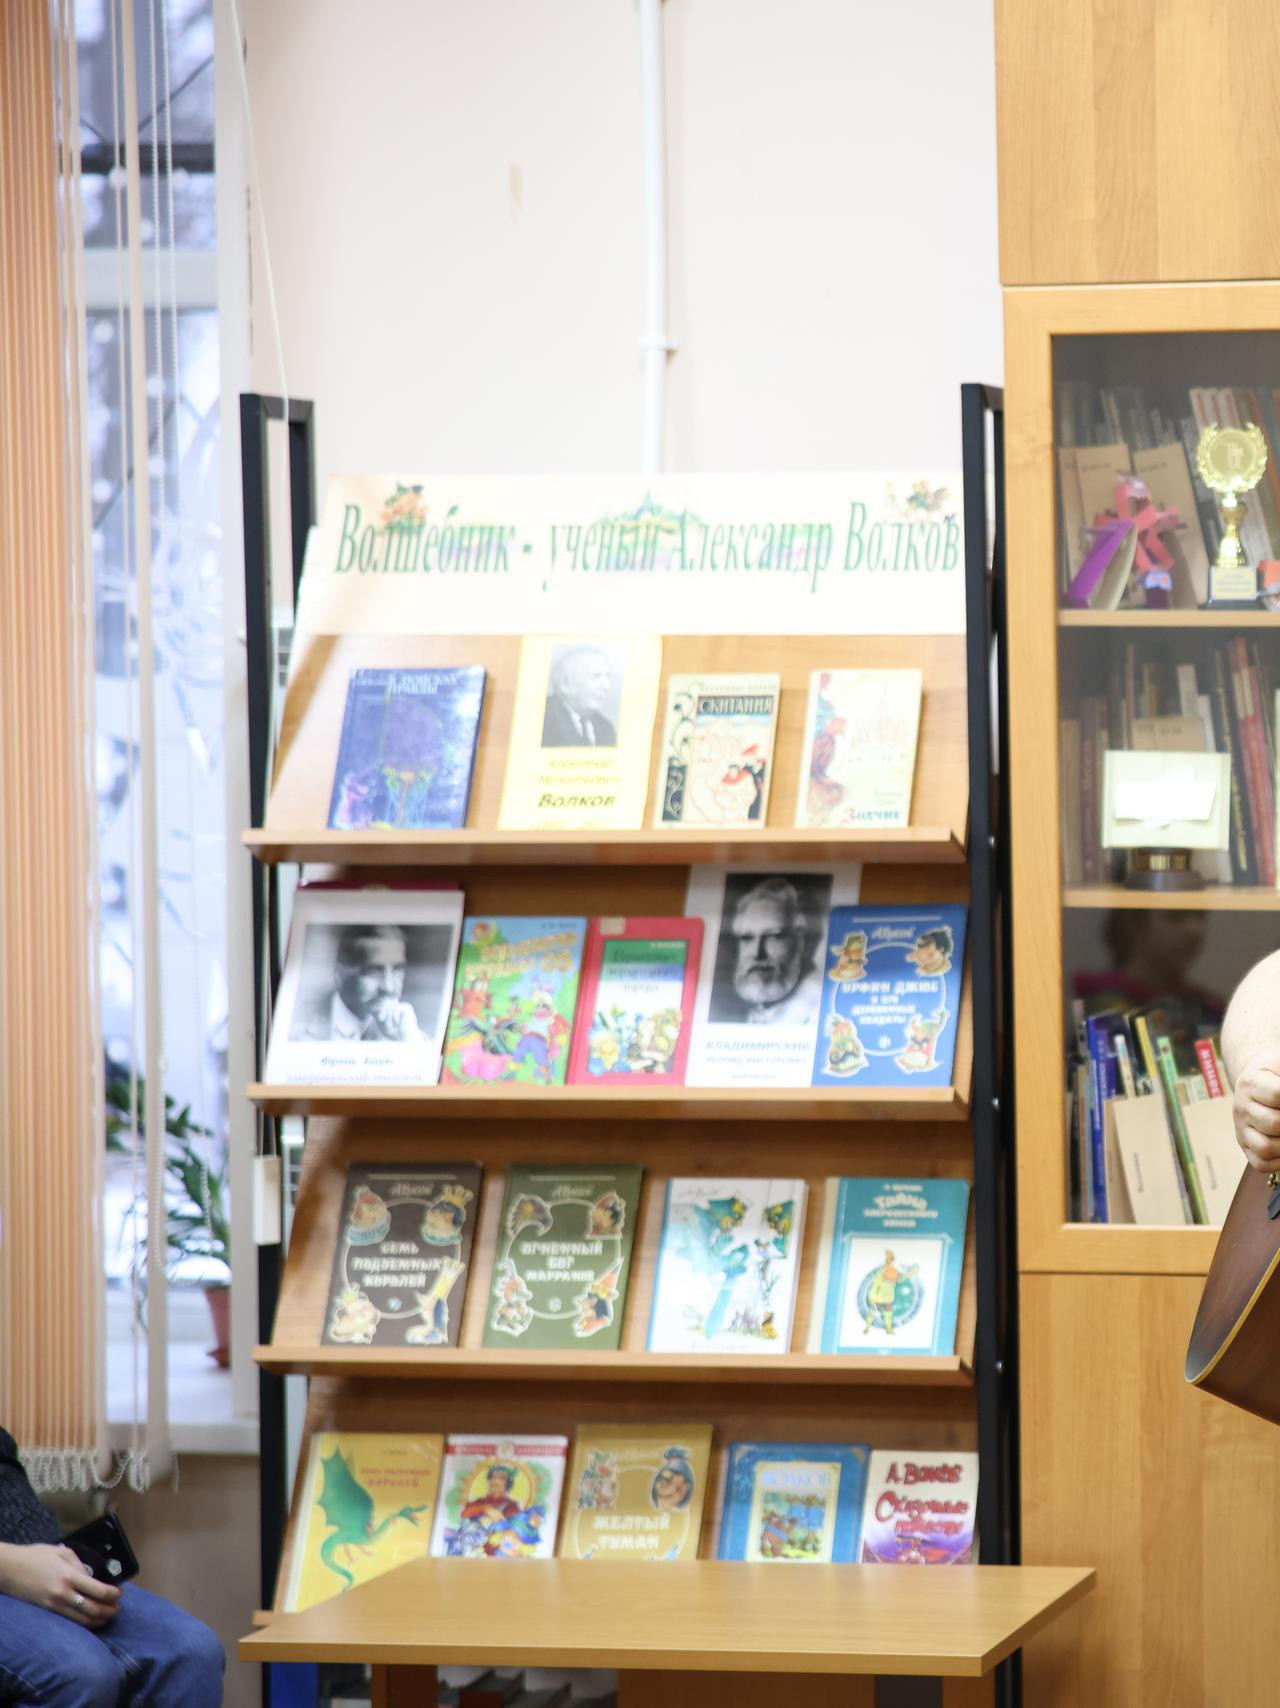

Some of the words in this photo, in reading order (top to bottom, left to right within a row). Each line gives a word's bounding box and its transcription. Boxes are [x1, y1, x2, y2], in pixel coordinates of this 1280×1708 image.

[335, 503, 516, 573] Волшебник
[664, 506, 832, 592] Александр
[843, 502, 960, 572] Волков
[701, 698, 773, 713] СКИТАНИЯ
[538, 793, 616, 808] Волков
[841, 980, 890, 994] УРФИН
[894, 980, 939, 997] ДЖЮС
[706, 1040, 811, 1052] ВЛАДИМИРСКИЙ
[380, 1241, 419, 1254] СЕМЬ
[521, 1240, 603, 1255] ОГНЕННЫЙ
[353, 1257, 441, 1273] ПОДЗЕМНЫХ
[547, 1255, 576, 1270] БОГ
[363, 1271, 426, 1288] КОРОЛЕЙ
[525, 1269, 595, 1281] МАРРАНОВ
[759, 1470, 834, 1489] ВОЛКОВ
[592, 1513, 671, 1531] ЖЕЛТЫЙ
[598, 1534, 660, 1550] ТУМАН
